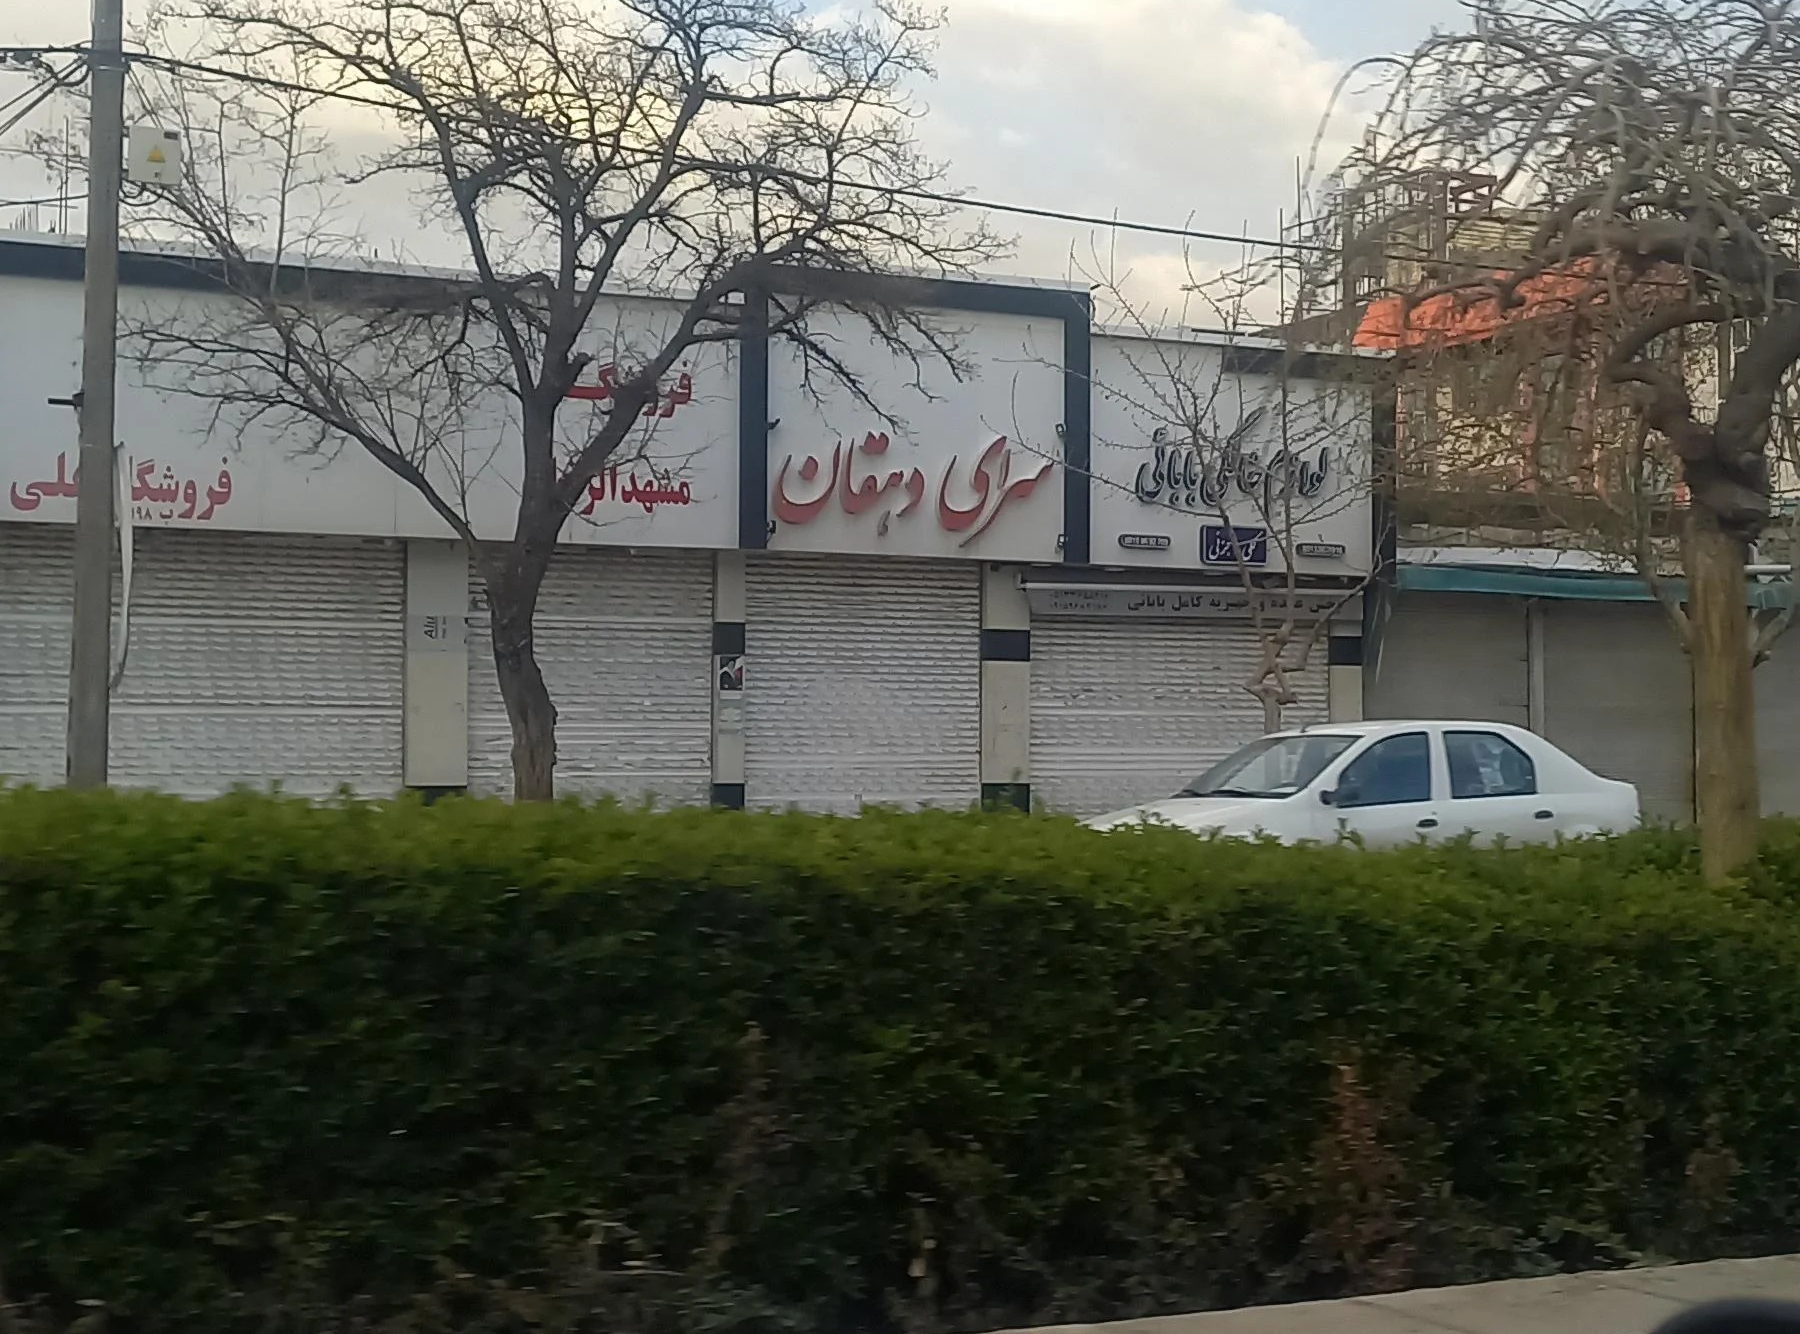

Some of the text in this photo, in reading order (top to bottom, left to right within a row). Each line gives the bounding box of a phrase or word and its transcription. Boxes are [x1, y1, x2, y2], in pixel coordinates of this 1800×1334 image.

[10, 451, 232, 521] فروشگا لی
[773, 431, 1055, 548] سرای دهقان
